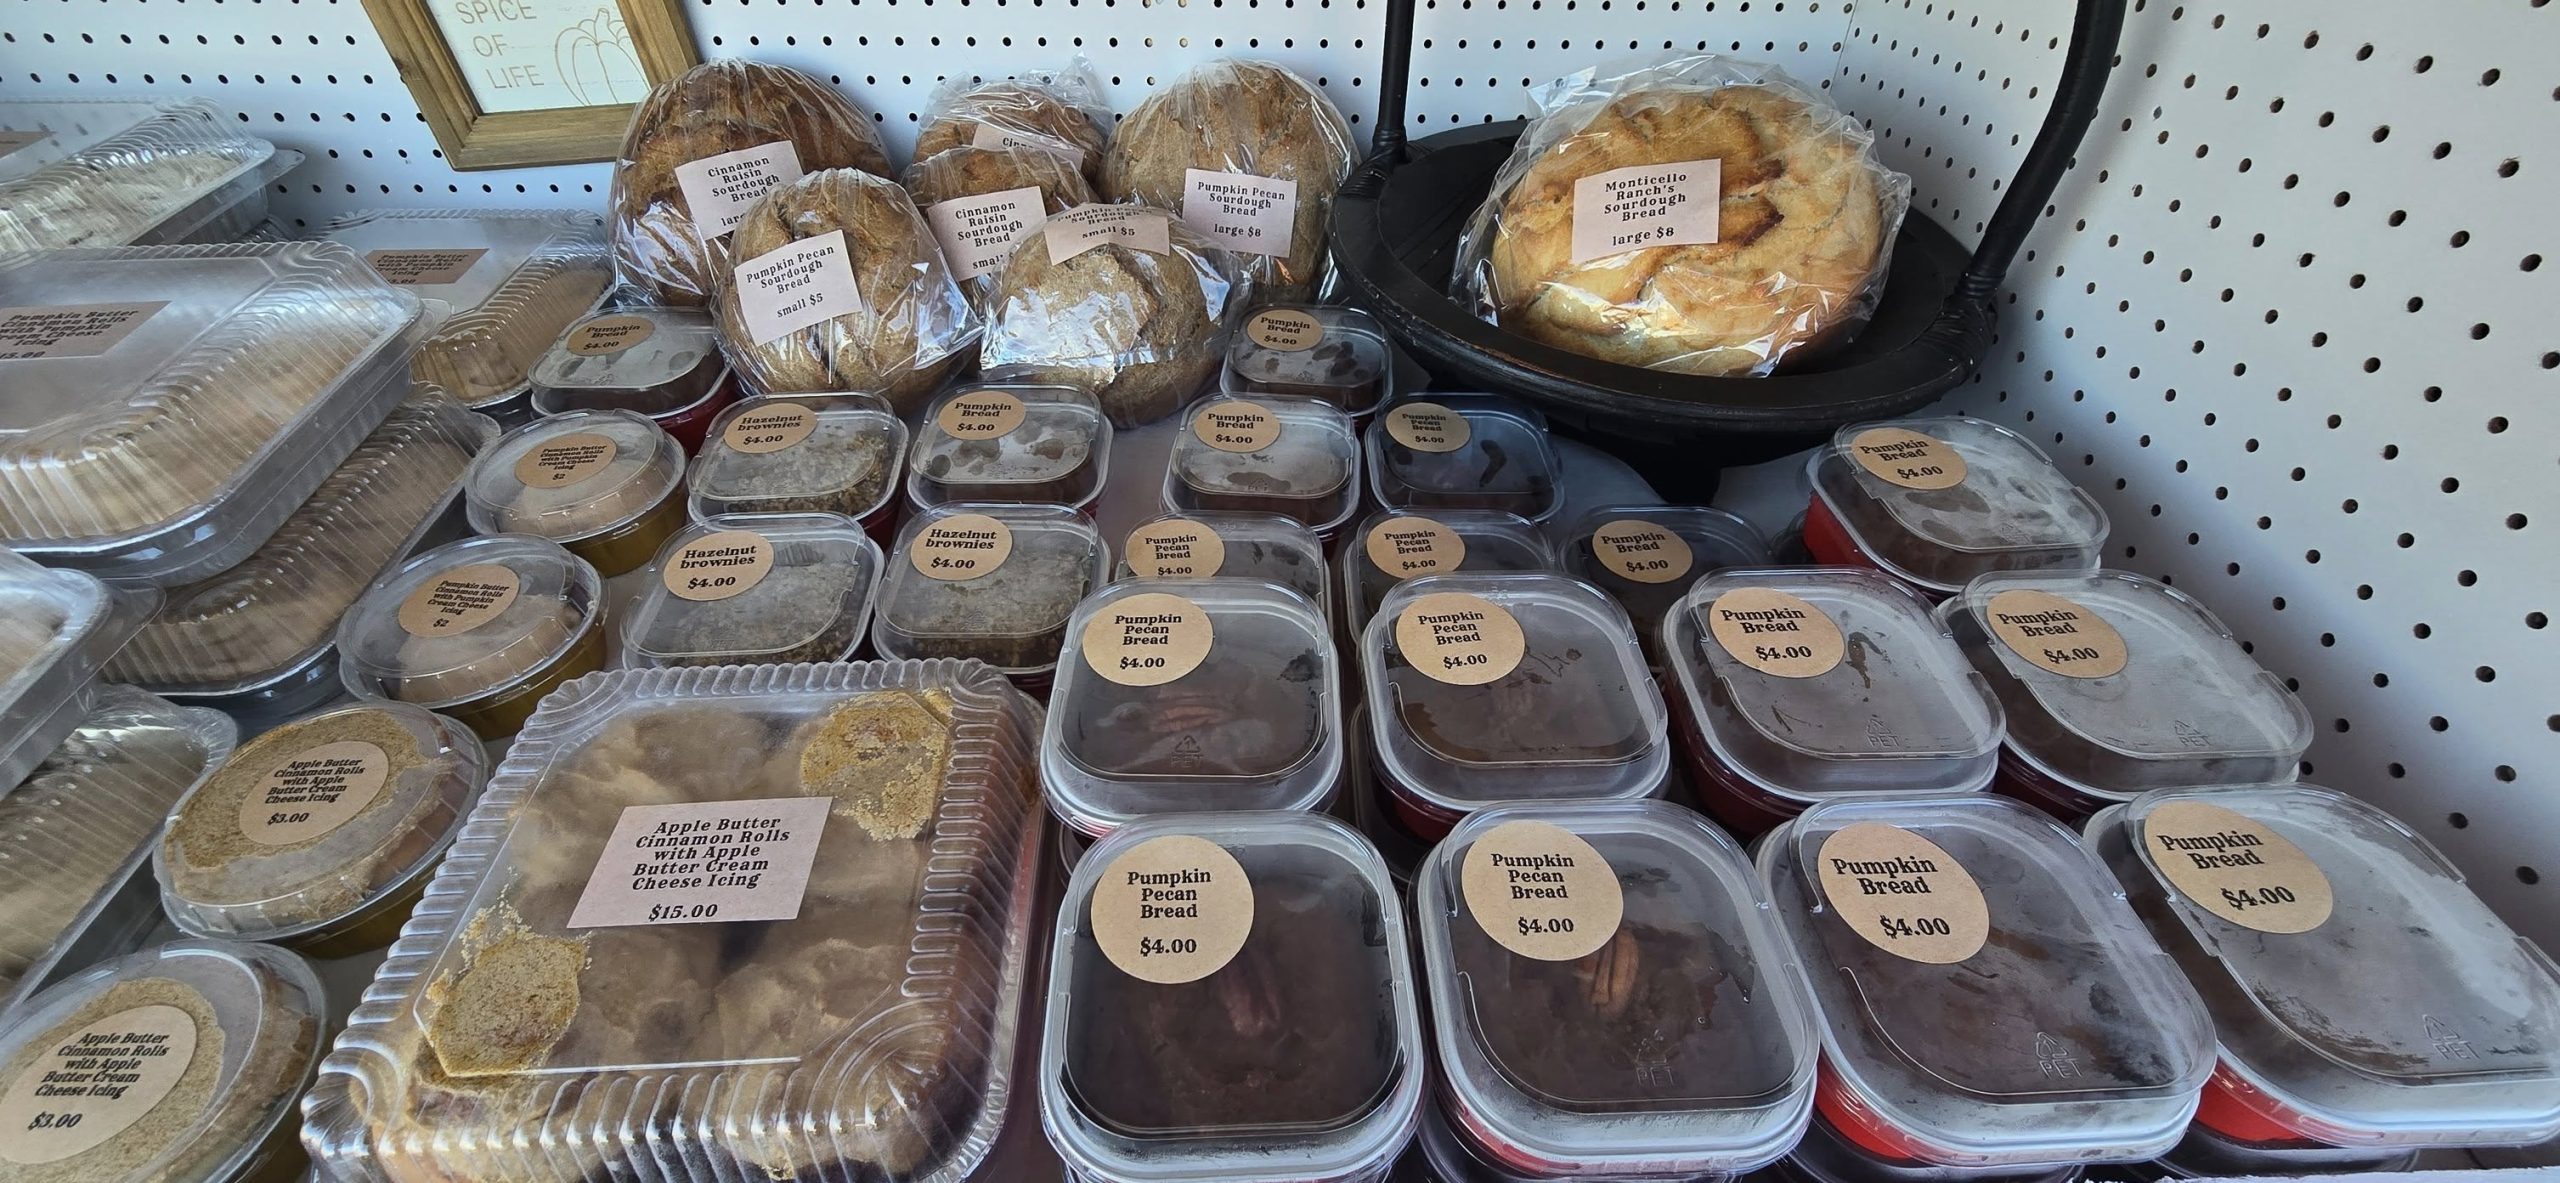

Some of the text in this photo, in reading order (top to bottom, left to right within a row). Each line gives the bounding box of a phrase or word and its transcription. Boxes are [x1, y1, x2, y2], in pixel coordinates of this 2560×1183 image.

[456, 0, 537, 24] SPICE
[473, 35, 507, 57] OF
[486, 65, 544, 88] LIFE
[708, 157, 770, 177] Cinnamon
[723, 169, 762, 184] Raisin
[1605, 174, 1686, 192] Monticello
[712, 174, 780, 197] Sourdough
[1198, 182, 1285, 200] Pumpkin Pecan
[731, 187, 767, 202] Bread
[1616, 185, 1674, 201] Ranch's
[1210, 193, 1271, 209] Sourdough
[1604, 194, 1686, 214] Sourdough
[955, 201, 1016, 219] Cinnamon
[1223, 204, 1256, 216] Bread
[1622, 206, 1666, 221] Bread
[969, 213, 1006, 227] Raisin
[1088, 216, 1125, 225] Bread
[958, 220, 1023, 241] Sourdough
[1082, 226, 1135, 238] small $5
[1214, 224, 1261, 237] large $8
[1613, 226, 1674, 246] large $8
[975, 233, 1010, 247] Bread
[746, 246, 834, 283] Pumpkin Pecan
[761, 260, 823, 288] Sourdough
[777, 274, 811, 294] Bread
[777, 293, 823, 317] small $5
[586, 325, 640, 333] Pumpkin
[1261, 317, 1310, 329] Pumpkin
[1267, 325, 1300, 334] Bread
[583, 342, 619, 350] $4.00
[1264, 335, 1297, 345] $4.00
[955, 403, 1011, 411] Pumpkin
[741, 415, 803, 424] Hazelnut
[1208, 414, 1264, 422] Pumpkin
[738, 422, 801, 431] brownies
[957, 423, 995, 431] $4.00
[1216, 421, 1254, 429] Bread
[743, 435, 783, 445] $4.00
[1216, 434, 1253, 443] $4.00
[1860, 440, 1929, 454] Pumpkin
[1879, 449, 1927, 461] Bread
[1897, 466, 1943, 479] $4.00
[929, 529, 997, 540] Hazelnut
[1145, 535, 1197, 545] Pumpkin
[1384, 531, 1436, 540] Pumpkin
[1601, 532, 1666, 544] Pumpkin
[925, 539, 994, 549] brownies
[1155, 544, 1189, 552] Pecan
[1397, 545, 1432, 554] Bread
[1616, 542, 1660, 553] Bread
[684, 545, 757, 559] Hazelnut
[1156, 551, 1191, 559] Bread
[680, 556, 756, 569] brownies
[931, 557, 975, 568] $4.00
[1402, 559, 1436, 570] $4.00
[1626, 560, 1668, 572] $4.00
[1158, 567, 1192, 575] $4.00
[440, 581, 480, 589] Pumpkin
[688, 577, 736, 589] $4.00
[435, 587, 479, 596] Cinnamon
[428, 599, 456, 607] Cream
[454, 595, 494, 604] Pumpkin
[441, 607, 466, 615] Icing
[1418, 611, 1484, 624] Pumpkin
[1720, 608, 1806, 622] Pumpkin
[1996, 610, 2079, 625] Pumpkin
[433, 619, 449, 627] $2
[1115, 614, 1182, 625] Pumpkin
[1125, 626, 1169, 634] Pecan
[1432, 623, 1477, 634] Pecan
[1740, 620, 1800, 634] Bread
[2019, 622, 2078, 637] Bread
[1122, 635, 1168, 645] Bread
[1435, 632, 1481, 645] Bread
[1756, 646, 1812, 661] $4.00
[2043, 648, 2099, 664] $4.00
[1120, 656, 1165, 670] $4.00
[1443, 654, 1487, 669] $4.00
[288, 759, 362, 770] Apple Butter
[274, 767, 365, 778] Cinnamon Rolls
[283, 776, 345, 787] with Apple
[267, 787, 308, 795] Butter
[265, 792, 341, 804] Cheese Icing
[268, 812, 310, 825] $3.00
[655, 818, 781, 836] Apple Butter
[636, 830, 790, 848] Cinnamon Rolls
[2156, 830, 2264, 852] Pumpkin
[655, 845, 761, 861] with Apple
[2187, 850, 2265, 869] Bread
[633, 859, 769, 876] Butter Cream
[1491, 853, 1574, 870] Pumpkin
[1830, 856, 1938, 878] Pumpkin
[633, 873, 762, 890] Cheese Icing
[1127, 868, 1212, 888] Pumpkin
[1508, 869, 1564, 883] Pecan
[1511, 885, 1569, 899] Bread
[1857, 876, 1932, 895] Bread
[1141, 888, 1197, 901] Pecan
[2220, 886, 2296, 911] $4.00
[649, 903, 718, 921] $15.00
[1140, 904, 1198, 918] Bread
[1518, 917, 1574, 936] $4.00
[1880, 915, 1950, 939] $4.00
[1140, 937, 1197, 957] $4.00
[77, 1032, 170, 1046] Apple Butter
[58, 1045, 170, 1057] Cinnamon Rolls
[64, 1058, 142, 1072] with Apple
[41, 1071, 141, 1083] Butter Cream
[34, 1084, 129, 1100] Cheese Icing
[28, 1110, 83, 1131] $3.00
